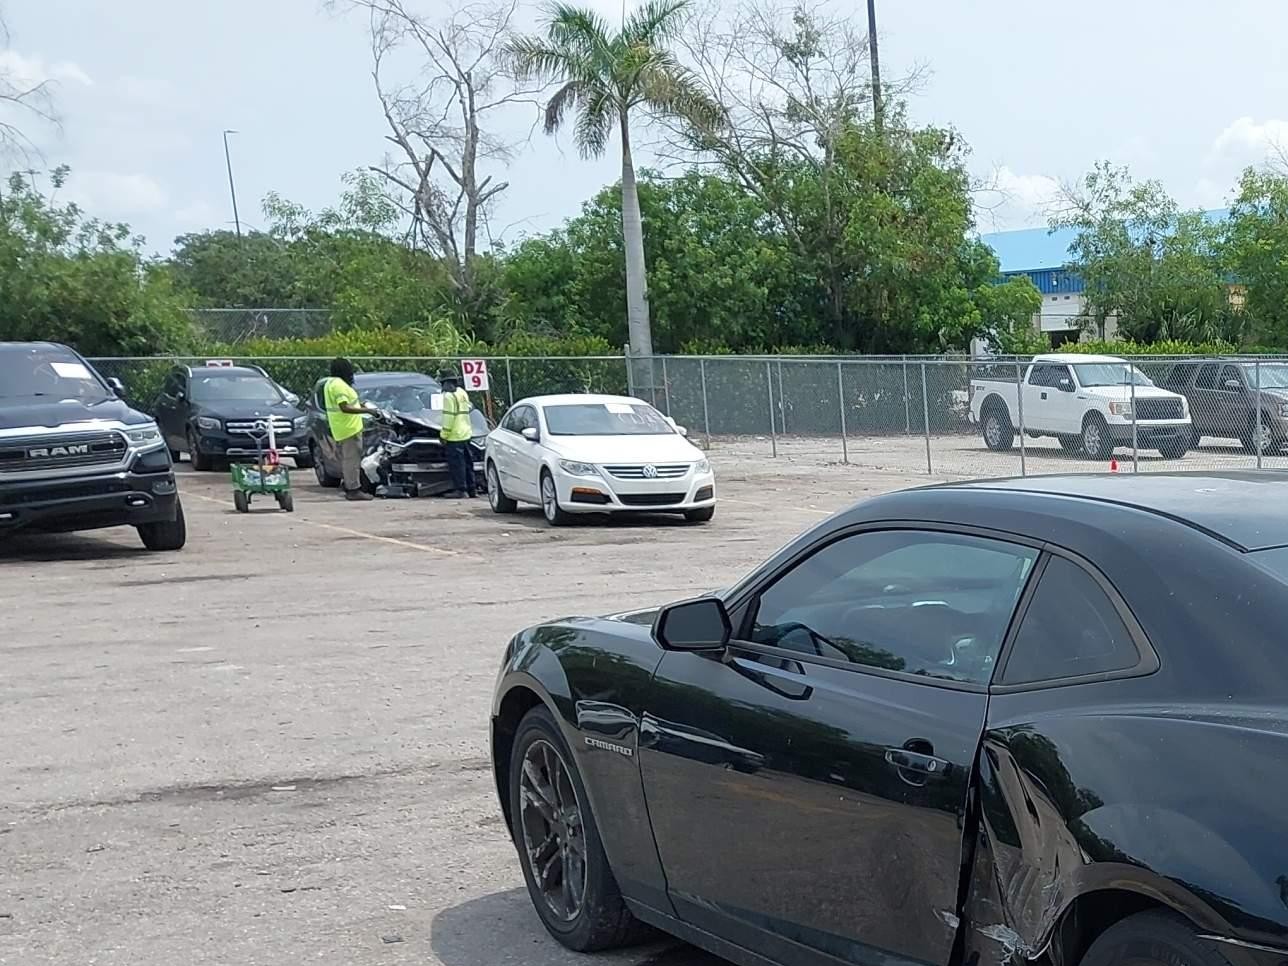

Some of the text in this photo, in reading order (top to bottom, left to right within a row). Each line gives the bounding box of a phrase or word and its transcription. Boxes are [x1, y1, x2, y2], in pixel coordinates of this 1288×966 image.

[463, 361, 485, 374] DZ
[471, 375, 482, 388] 9
[29, 444, 88, 457] RAM
[584, 736, 633, 756] CAMARO
